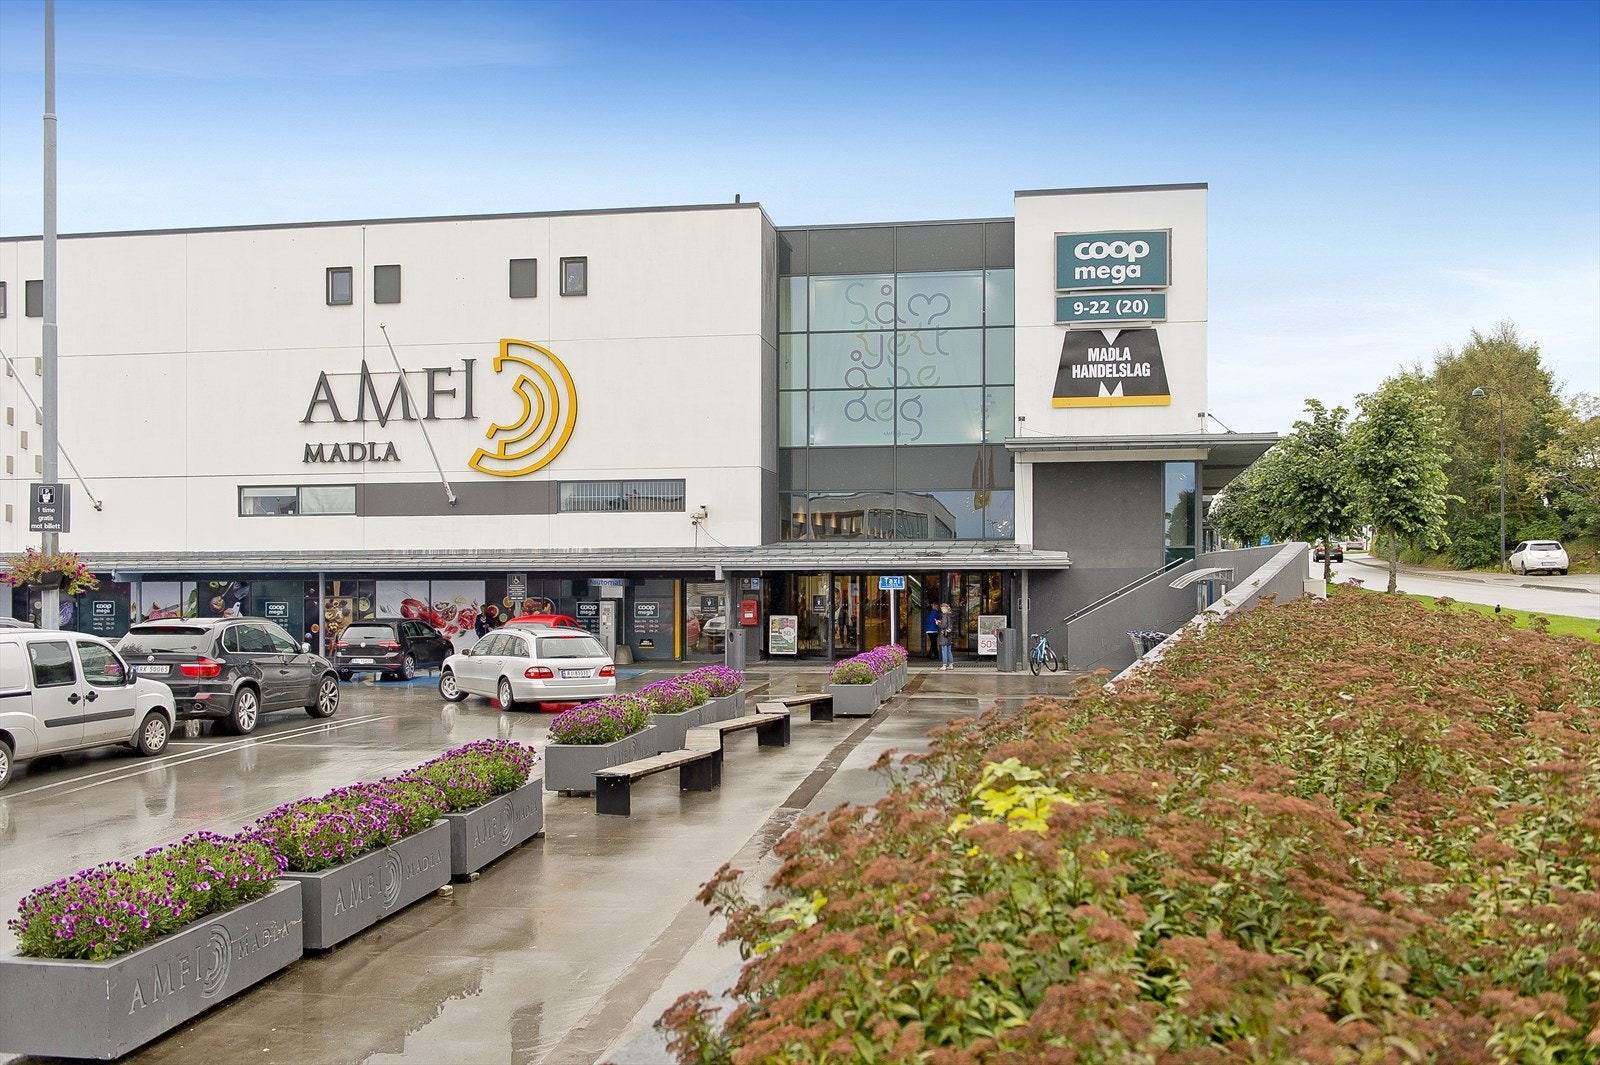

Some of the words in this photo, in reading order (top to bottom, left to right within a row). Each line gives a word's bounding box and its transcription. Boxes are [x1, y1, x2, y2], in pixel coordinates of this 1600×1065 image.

[1074, 240, 1150, 263] coop
[1074, 264, 1141, 284] mega
[1073, 300, 1110, 315] 9-22
[1115, 299, 1149, 316] (20)
[1087, 346, 1132, 362] MADLA
[1072, 362, 1151, 379] HANDELSLAG
[299, 358, 480, 428] AMFI
[302, 441, 401, 463] MADLA
[884, 577, 900, 586] Taxi
[334, 865, 383, 916] AMFI
[128, 946, 202, 1015] AMFI
